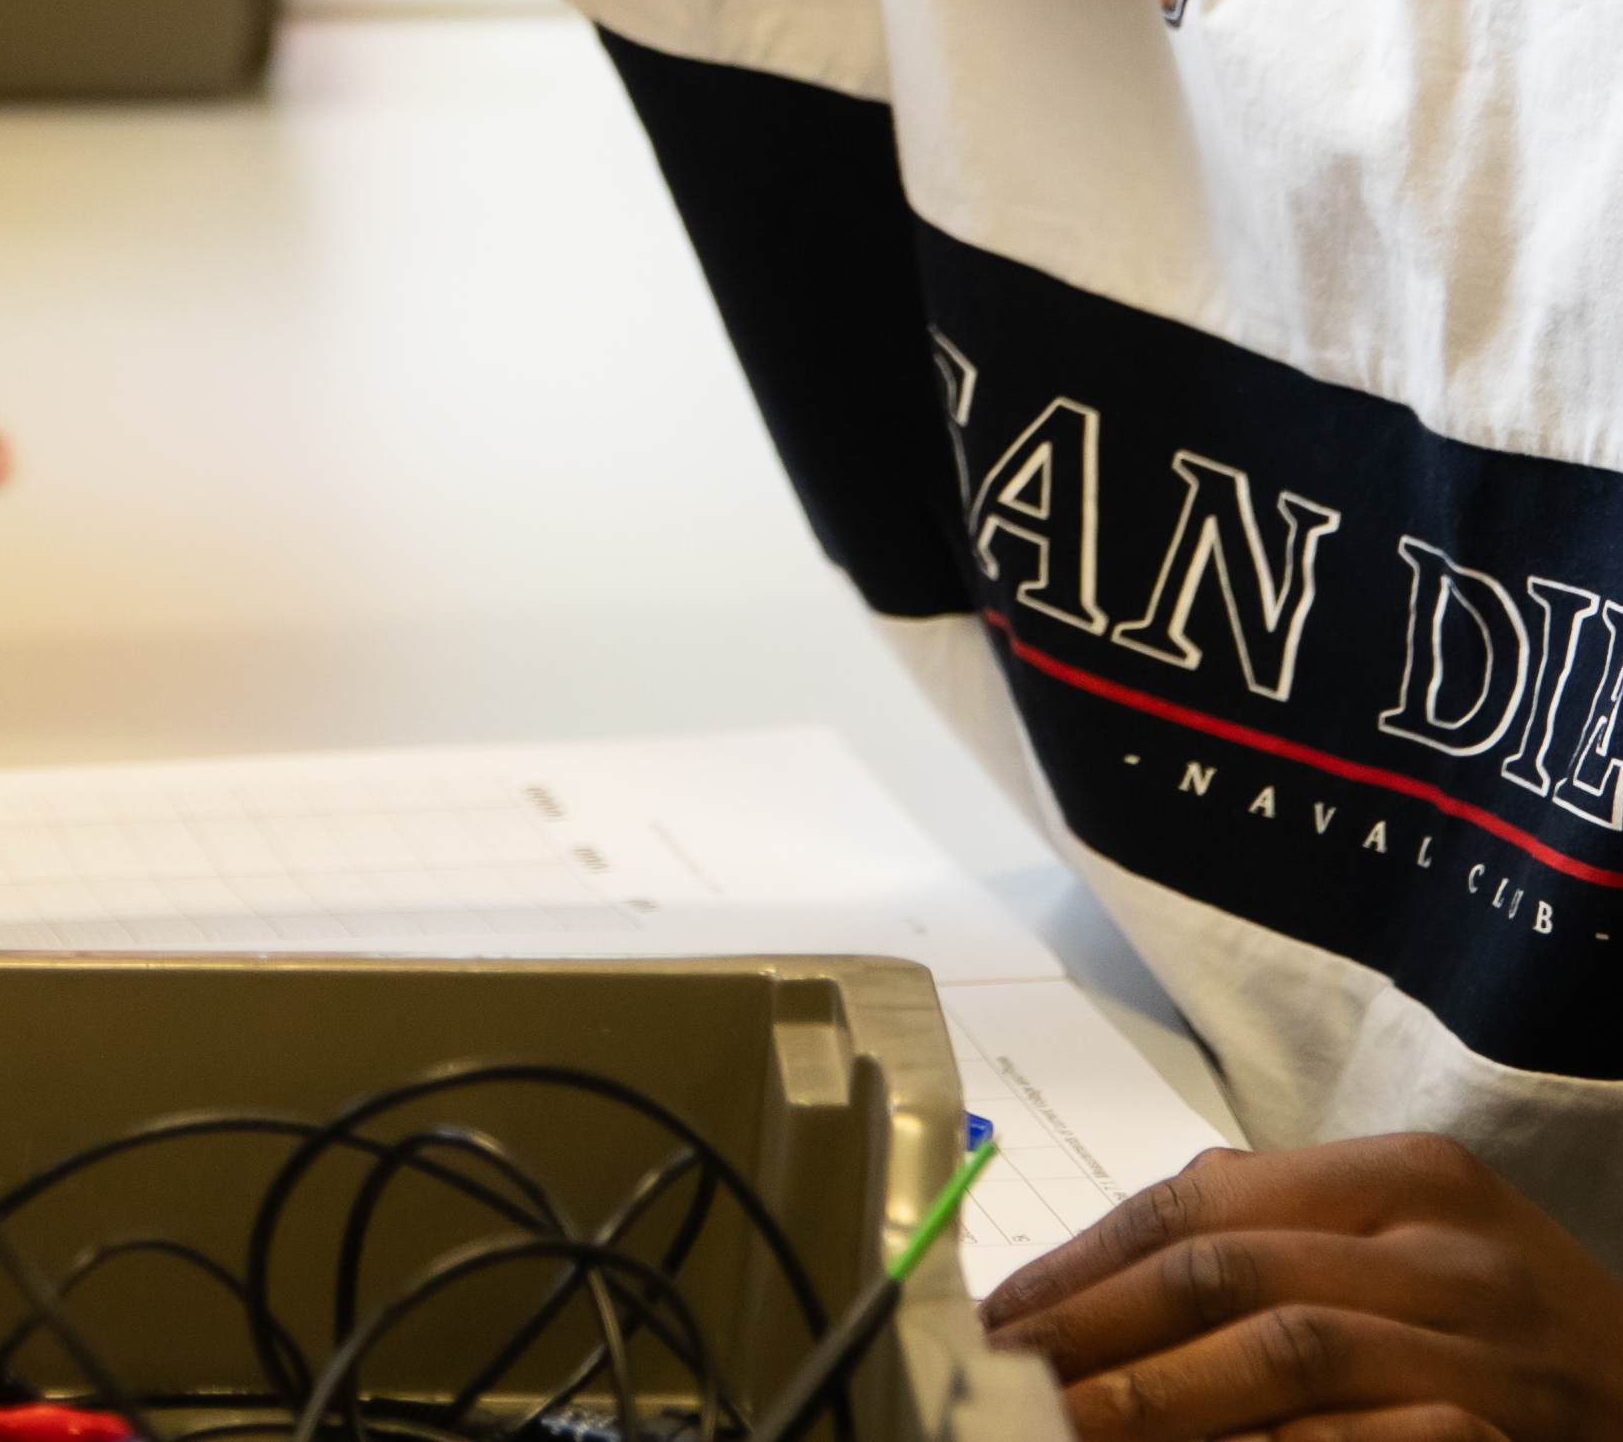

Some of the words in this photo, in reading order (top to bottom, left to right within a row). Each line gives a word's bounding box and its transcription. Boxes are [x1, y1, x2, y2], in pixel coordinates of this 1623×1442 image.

[929, 323, 1340, 701] AN
[1178, 760, 1433, 869] NAVAL
[1467, 863, 1555, 935] CLUB
